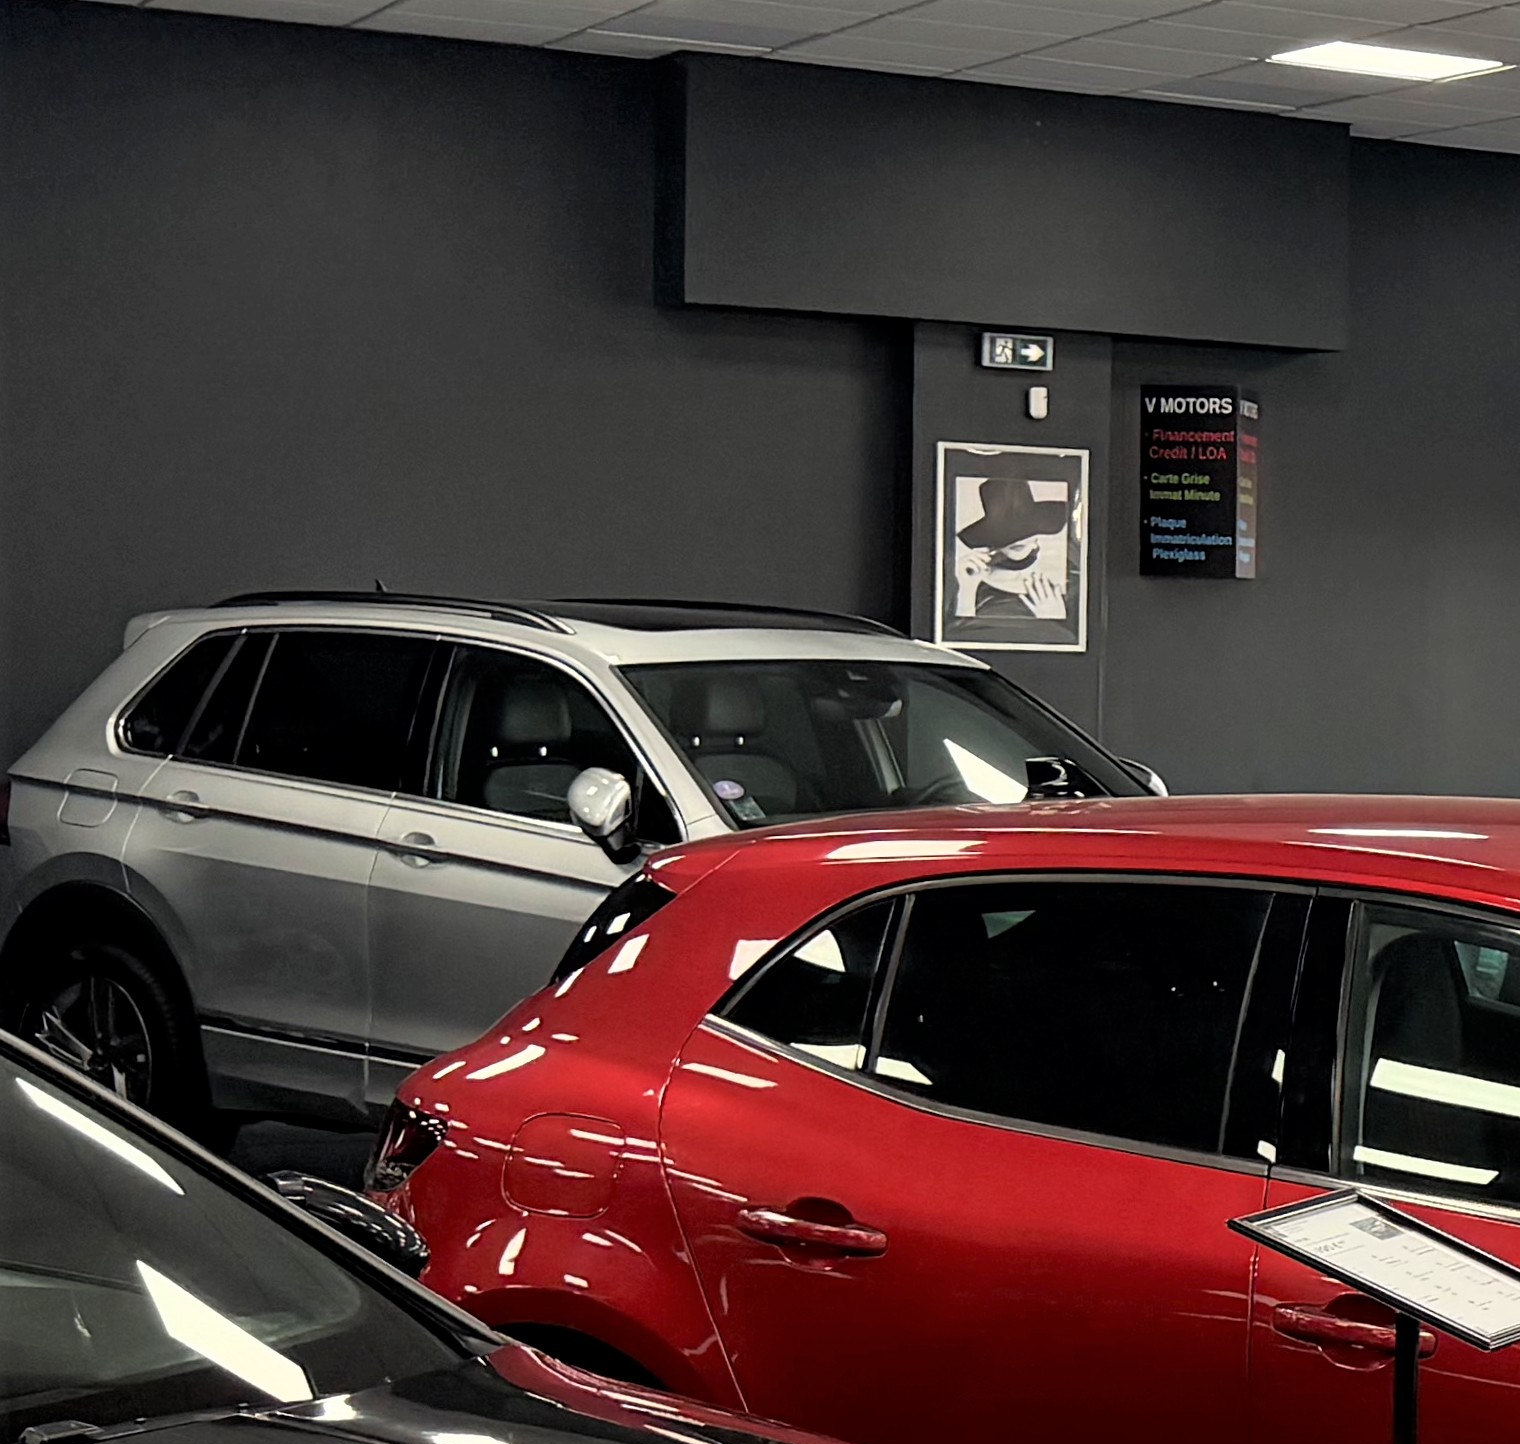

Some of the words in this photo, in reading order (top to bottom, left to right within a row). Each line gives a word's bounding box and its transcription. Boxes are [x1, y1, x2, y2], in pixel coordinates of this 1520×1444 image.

[1144, 397, 1157, 414] V
[1160, 397, 1233, 415] MOTORS
[1152, 429, 1235, 443] Financement
[1199, 447, 1228, 460] LOA
[1150, 472, 1179, 485] Carte
[1181, 472, 1211, 485] Grise
